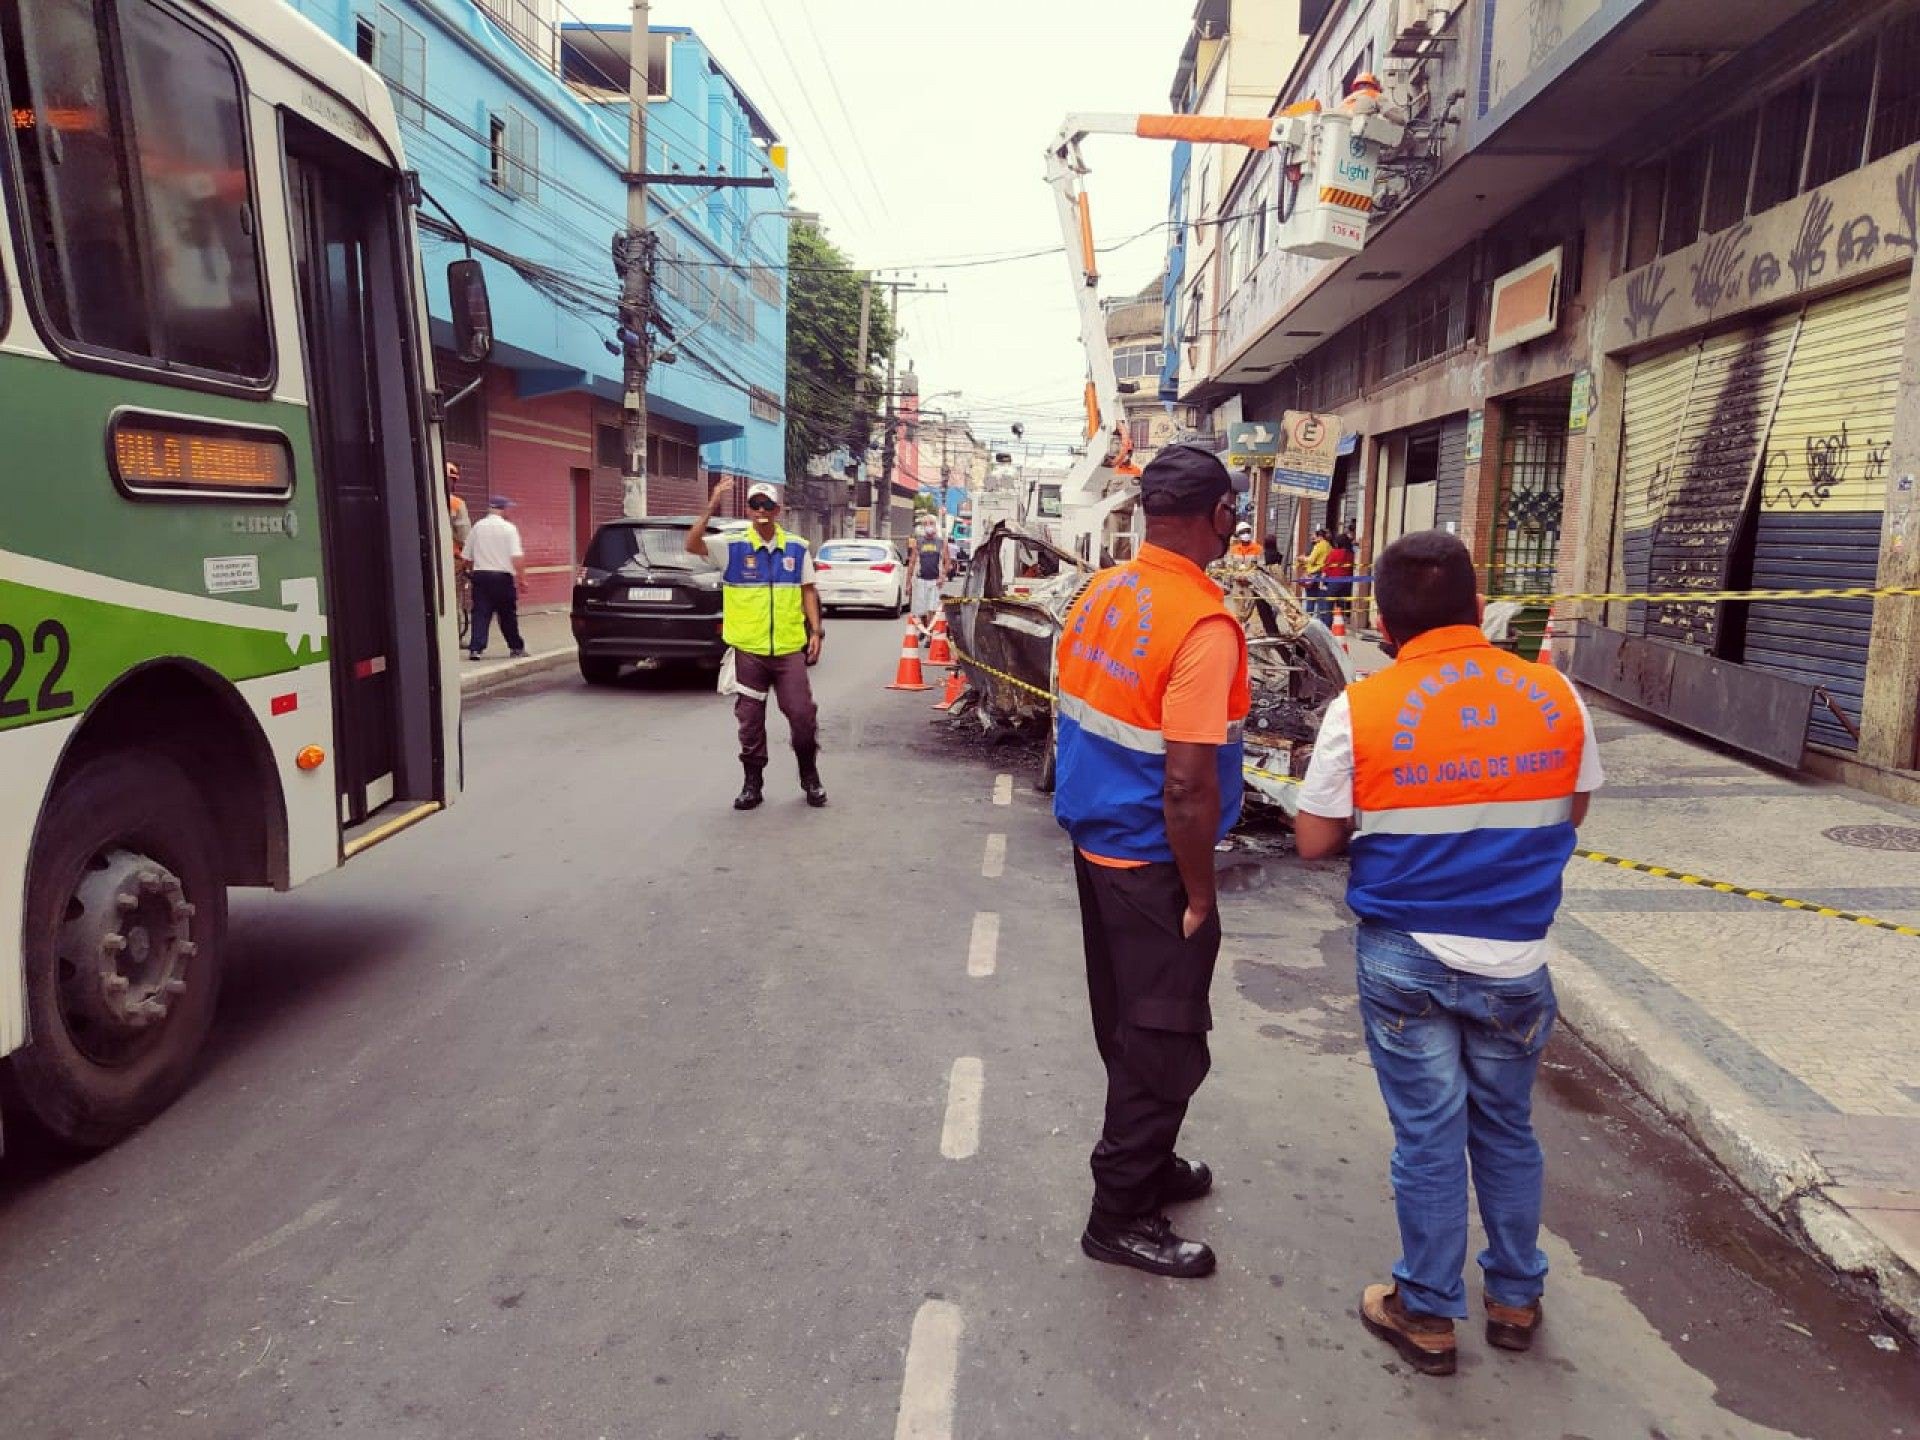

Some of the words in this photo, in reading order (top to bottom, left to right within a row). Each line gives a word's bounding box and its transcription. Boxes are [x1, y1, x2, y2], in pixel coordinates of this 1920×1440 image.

[1338, 158, 1370, 182] Light
[1303, 422, 1318, 441] E
[1393, 659, 1484, 750] DEFESA
[1496, 666, 1561, 731] CIVIL
[1460, 704, 1497, 729] RJ
[1393, 762, 1429, 787] SÃO
[1435, 756, 1481, 783] JOÃO
[1488, 755, 1510, 778] DE
